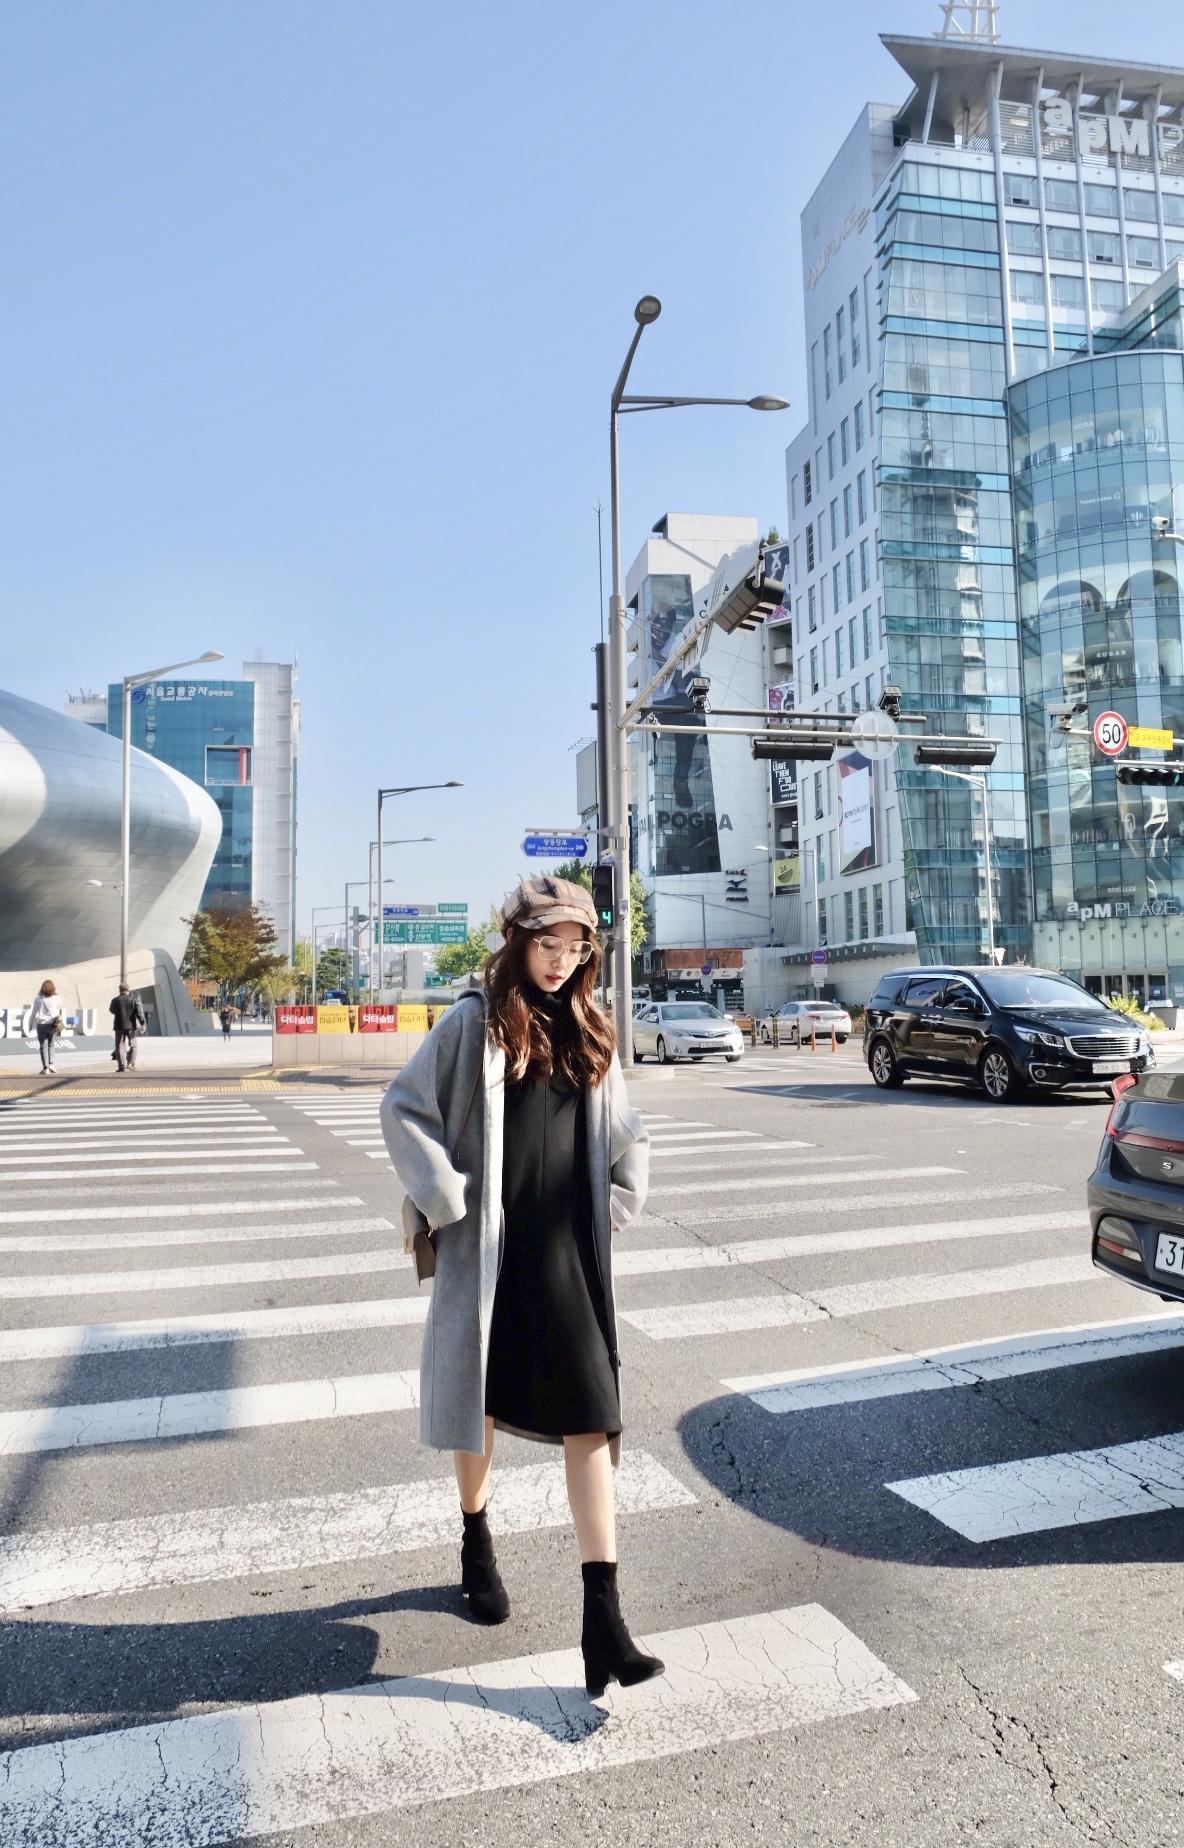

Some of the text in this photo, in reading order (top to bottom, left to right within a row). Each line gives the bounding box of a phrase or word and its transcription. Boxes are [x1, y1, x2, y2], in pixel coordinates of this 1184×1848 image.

[1044, 97, 1150, 157] apM
[1073, 421, 1094, 430] vona
[146, 686, 208, 697] 서울교통공사
[1102, 723, 1122, 744] 50
[602, 911, 612, 925] 4
[1066, 900, 1178, 922] apM PLACE
